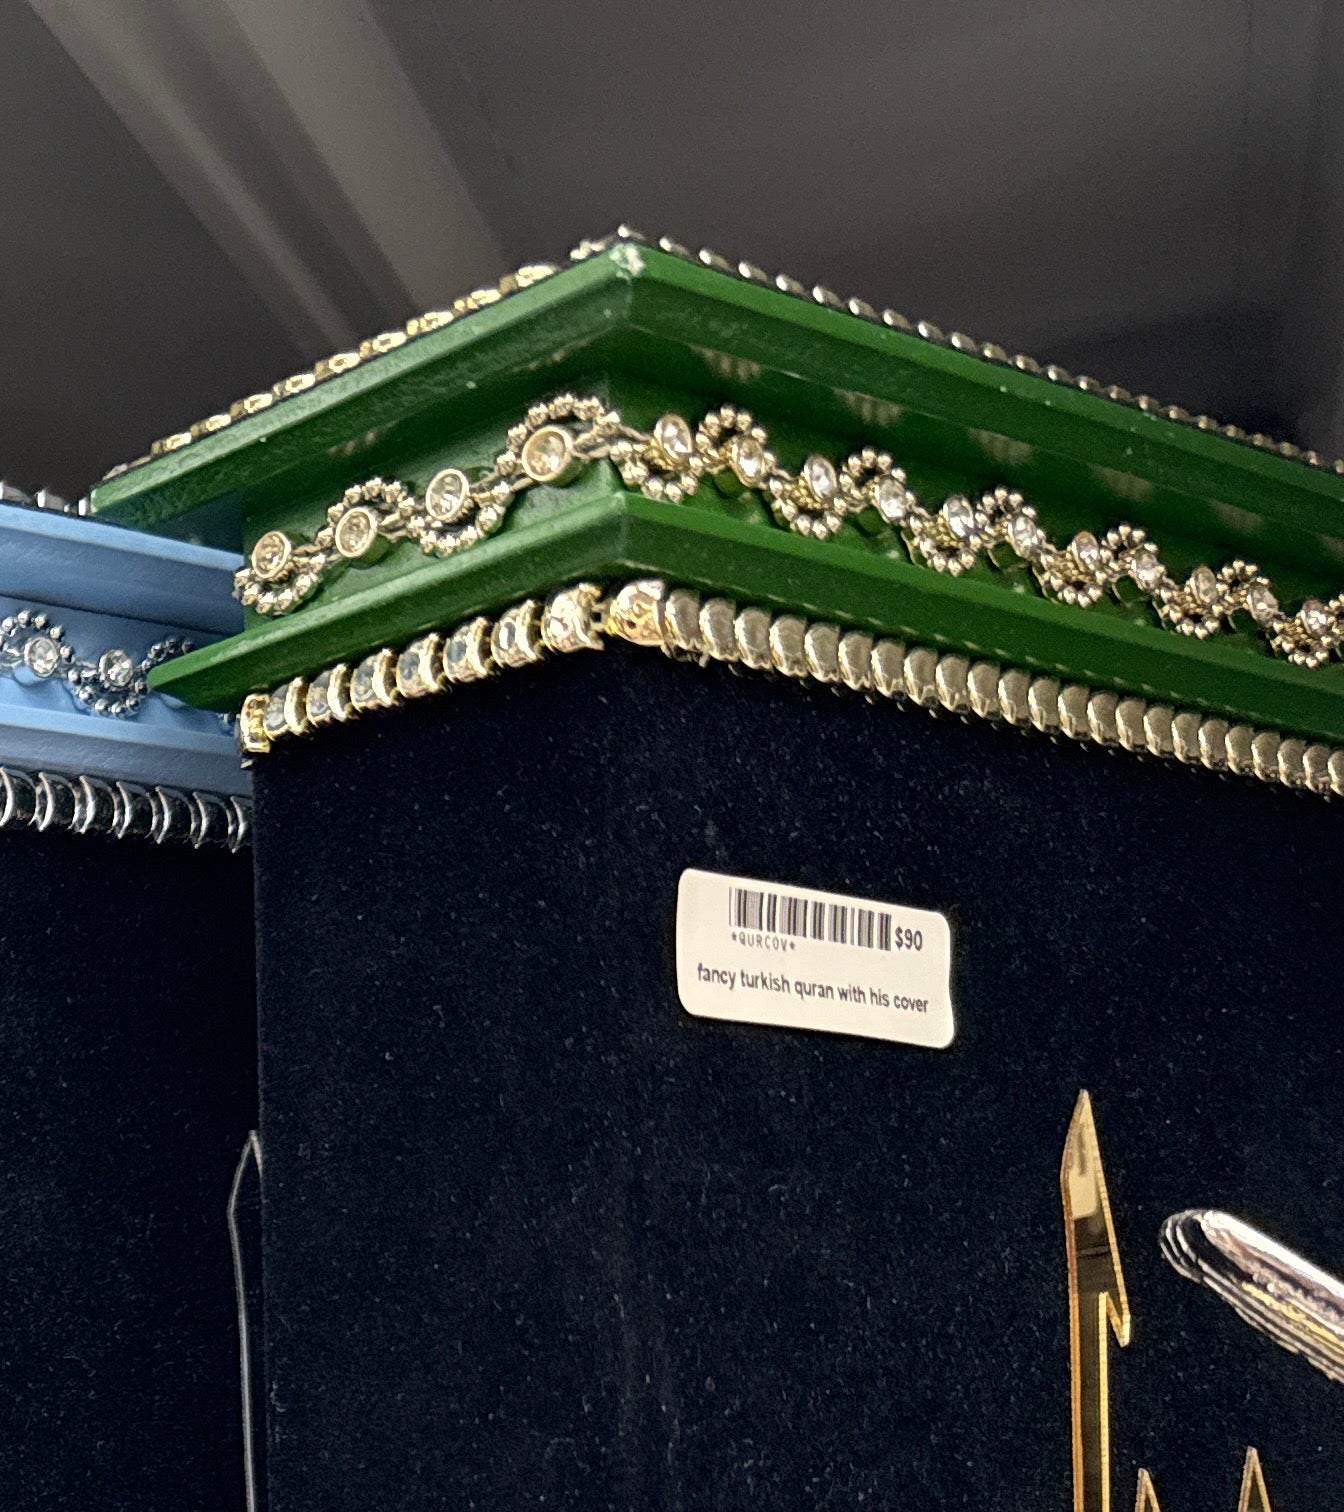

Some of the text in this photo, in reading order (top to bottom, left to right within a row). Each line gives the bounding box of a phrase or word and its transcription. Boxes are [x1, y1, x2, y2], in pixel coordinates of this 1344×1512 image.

[894, 925, 924, 952] $90
[696, 961, 929, 1014] fancy turkish quran with his cover
